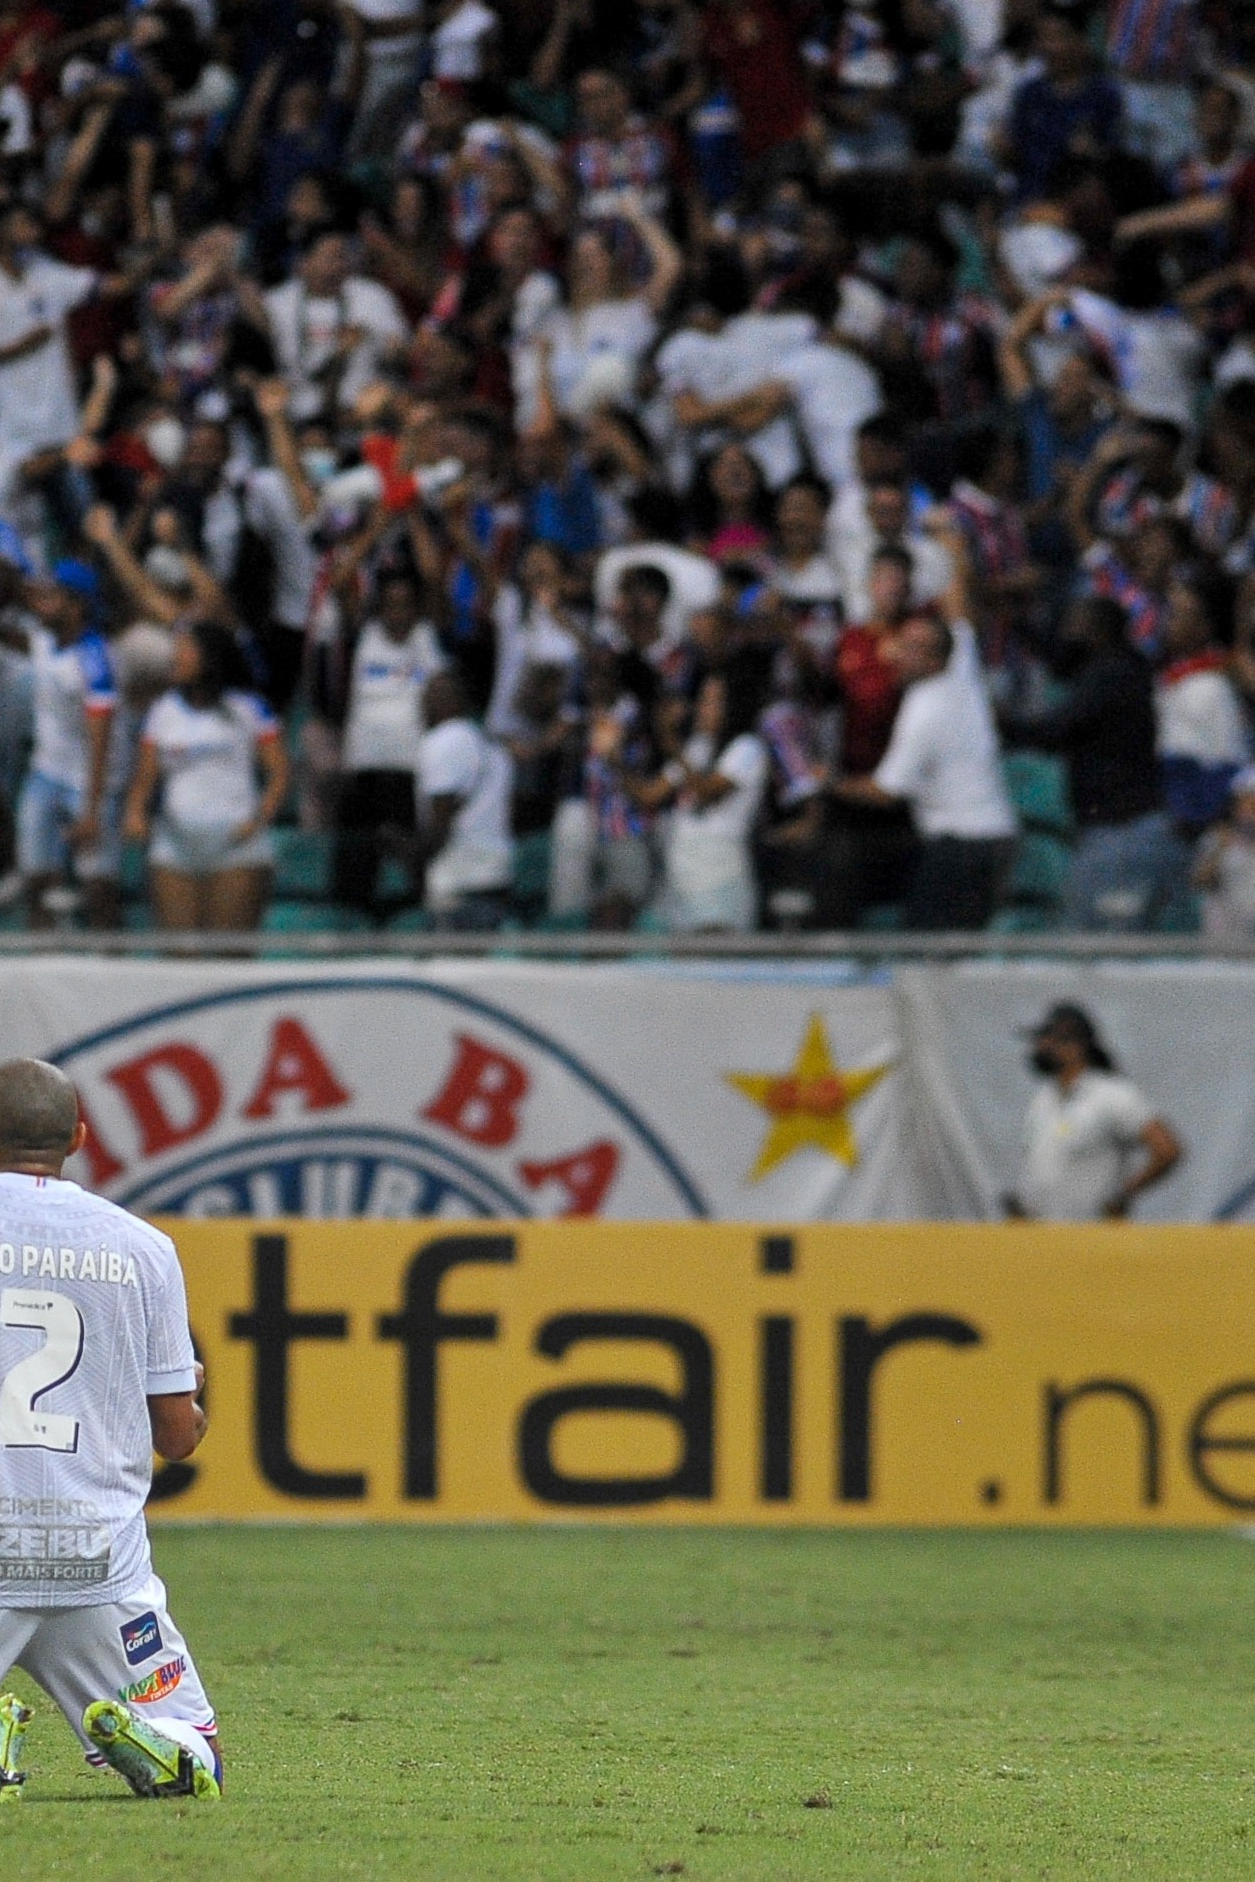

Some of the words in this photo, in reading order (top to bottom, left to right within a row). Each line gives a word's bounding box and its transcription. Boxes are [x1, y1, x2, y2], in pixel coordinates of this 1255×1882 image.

[21, 1242, 138, 1289] PARAÍBA
[6, 1564, 50, 1580] MAIS
[53, 1565, 105, 1580] FORTE
[126, 1630, 154, 1653] Coral
